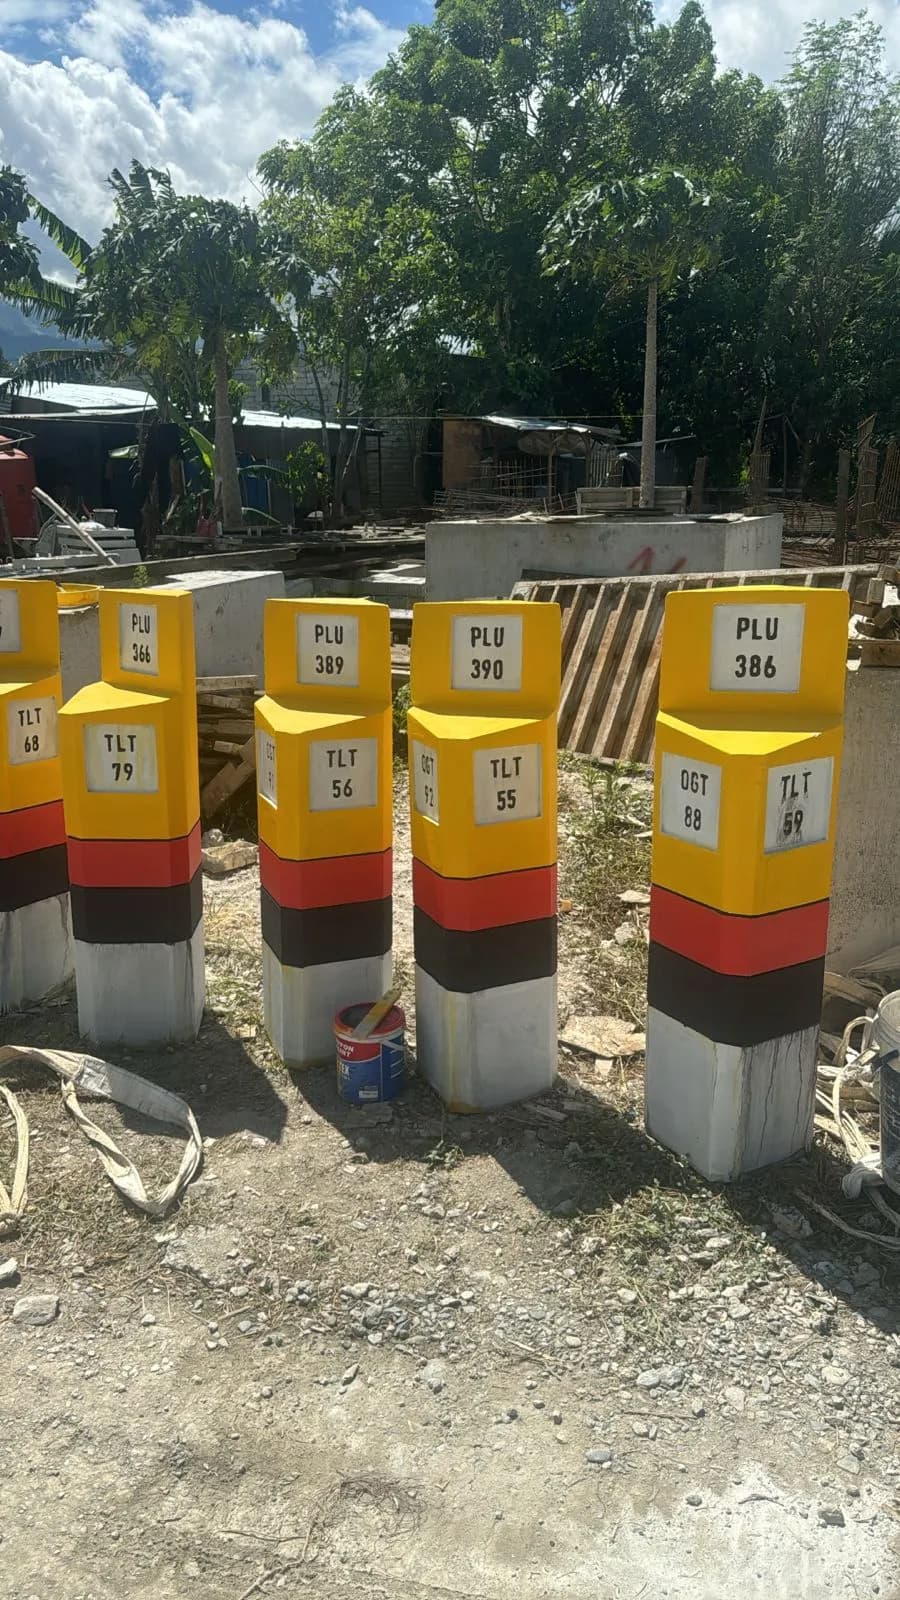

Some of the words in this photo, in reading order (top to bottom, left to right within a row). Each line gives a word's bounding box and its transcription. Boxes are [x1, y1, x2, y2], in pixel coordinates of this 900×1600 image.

[132, 613, 151, 634] PLU
[736, 617, 779, 641] PLU
[314, 624, 344, 645] PLU
[470, 626, 505, 648] PLU
[132, 643, 151, 663] 366
[315, 655, 344, 674] 389
[470, 659, 504, 680] 390
[734, 654, 777, 679] 386
[18, 708, 42, 727] TLT
[24, 735, 39, 753] 68
[104, 734, 137, 753] TLT
[326, 749, 358, 768] TLT
[490, 756, 522, 779] TLT
[111, 763, 133, 782] 79
[680, 769, 709, 796] OGT
[332, 779, 353, 799] 56
[781, 771, 812, 799] TLT
[496, 789, 517, 811] 55
[684, 805, 702, 831] 88
[782, 810, 804, 836] 59
